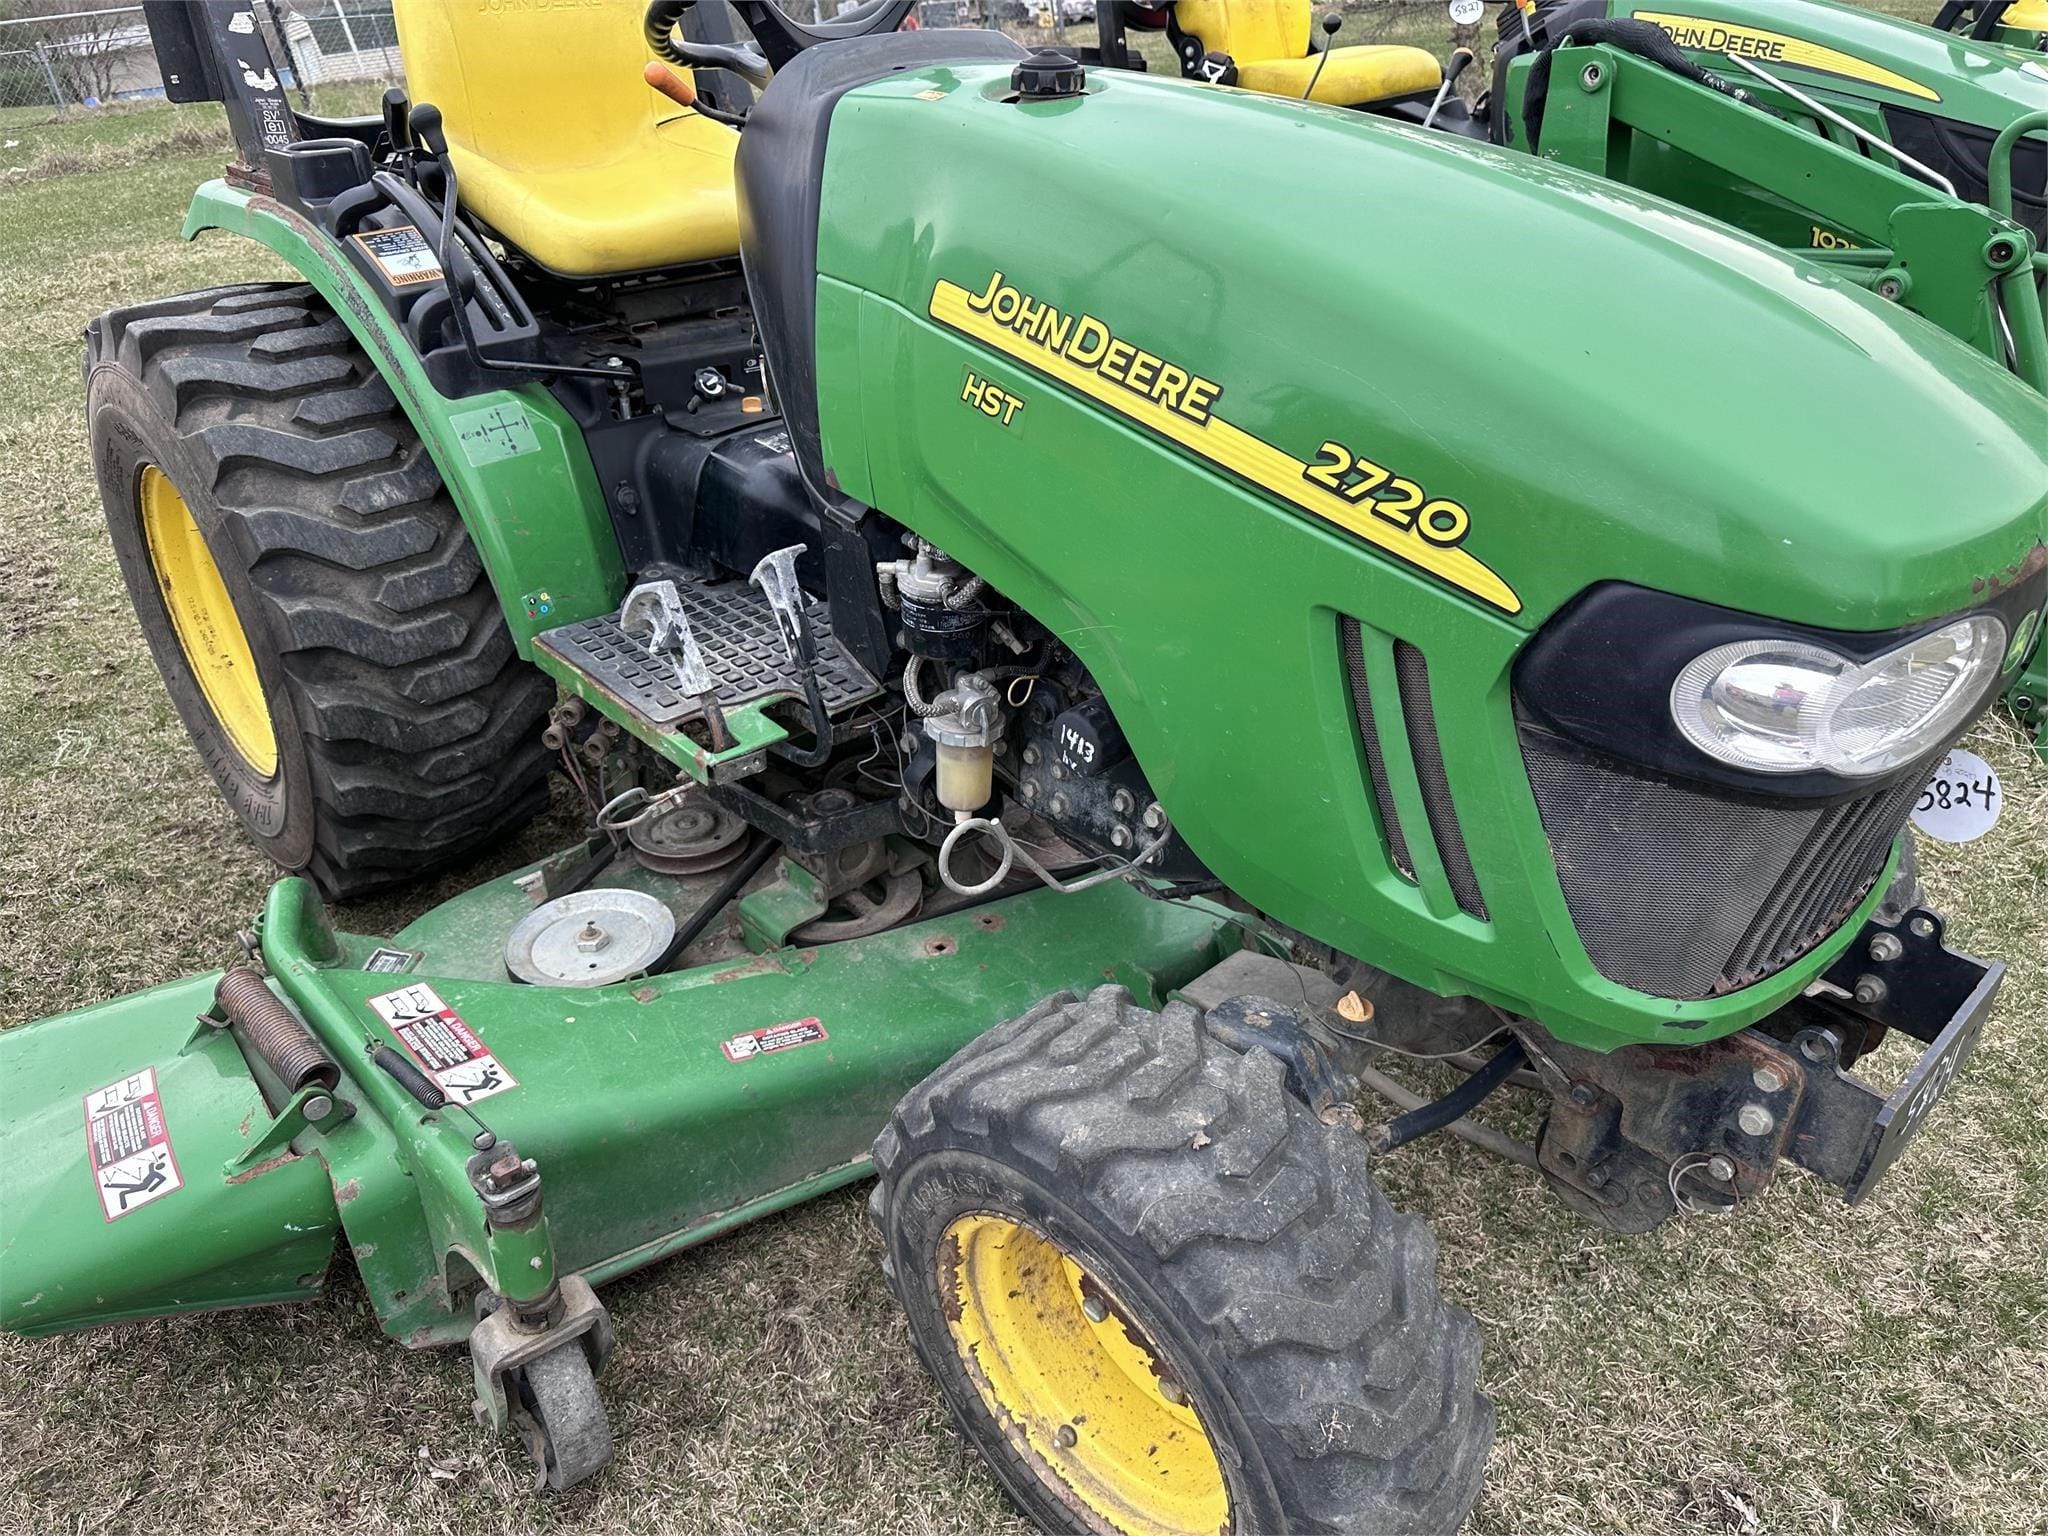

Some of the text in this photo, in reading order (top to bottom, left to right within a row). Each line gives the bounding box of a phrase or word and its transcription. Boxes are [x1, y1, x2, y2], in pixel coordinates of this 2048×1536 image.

[1455, 1, 1479, 17] 5827
[1708, 28, 1786, 59] DEERE
[392, 269, 440, 284] WARNING
[960, 372, 1026, 427] HST
[1303, 440, 1471, 548] 2720
[451, 1020, 483, 1050] DANGER
[145, 1104, 163, 1138] DANGER
